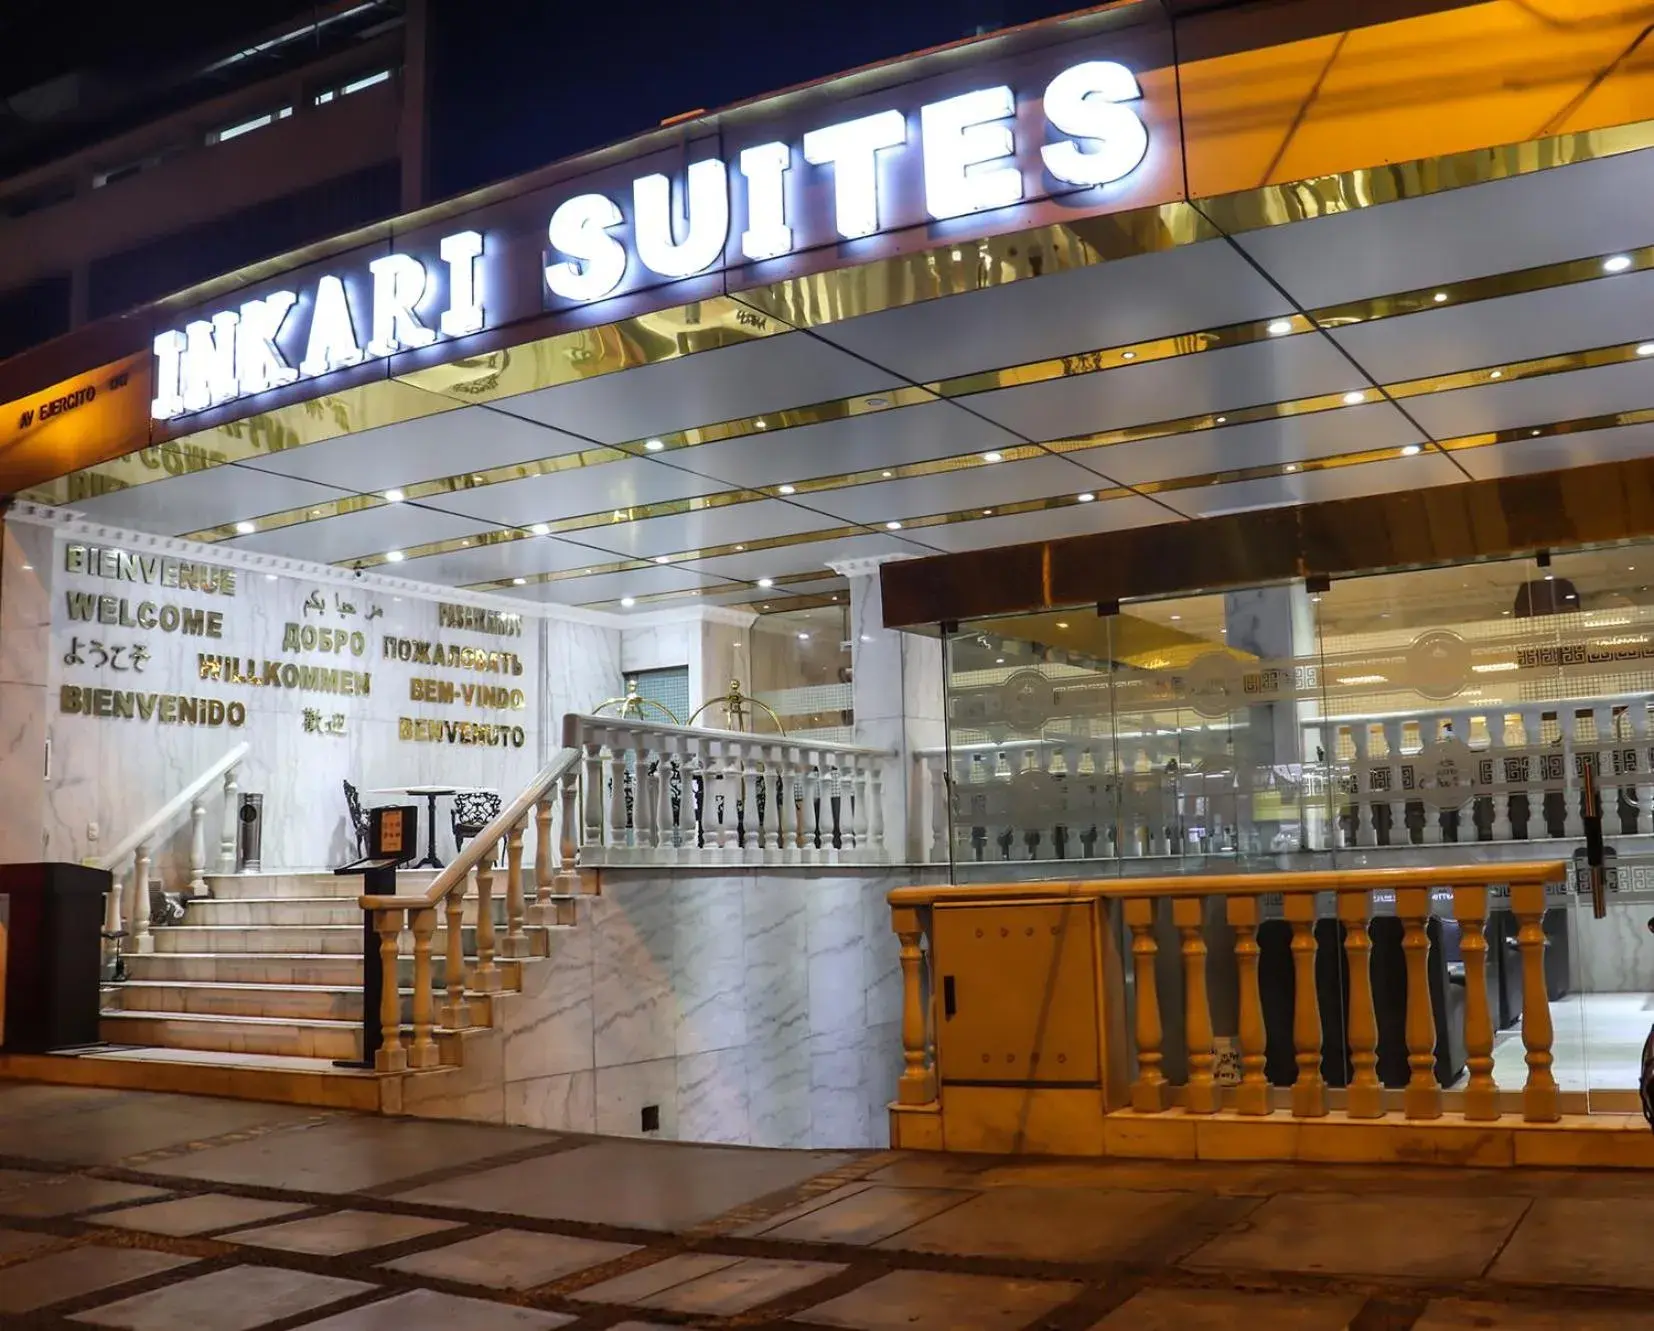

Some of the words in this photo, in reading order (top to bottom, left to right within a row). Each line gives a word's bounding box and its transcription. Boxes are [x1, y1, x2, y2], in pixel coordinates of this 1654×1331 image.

[151, 230, 486, 421] INKARI
[544, 59, 1152, 304] SUITES
[18, 410, 35, 429] AV
[39, 385, 96, 420] EJERCITO
[66, 543, 236, 596] BIENVENUE
[66, 590, 224, 638] WELCOME
[63, 636, 152, 673] ようこそ
[282, 622, 366, 656] ДОБРО
[383, 635, 523, 676] ПОЖАЛОВАТЬ
[197, 653, 372, 697] WILLKOMMEN
[410, 678, 525, 710] BEM-VINDO
[302, 707, 348, 738] 歡迎
[399, 717, 525, 748] BENVENUTO
